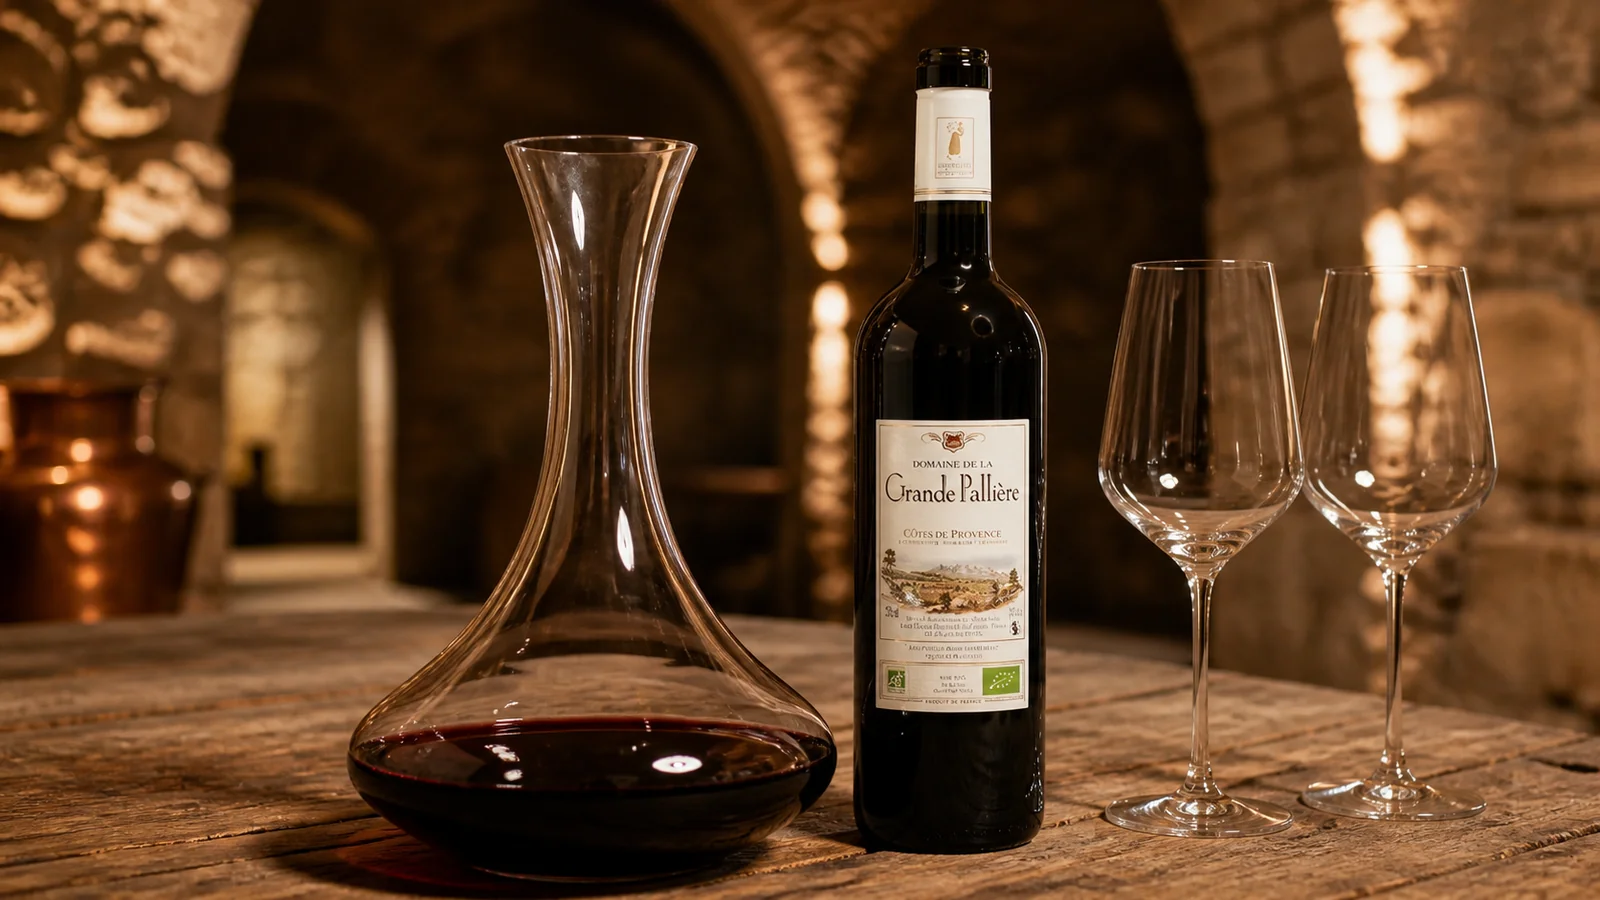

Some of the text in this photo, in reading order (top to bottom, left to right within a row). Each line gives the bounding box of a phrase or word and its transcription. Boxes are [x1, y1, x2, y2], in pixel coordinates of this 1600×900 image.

[912, 460, 993, 469] DOMAINE DE LA
[885, 472, 1020, 503] Grande Pallière
[903, 528, 1002, 539] CÔTES DE PROVENCE
